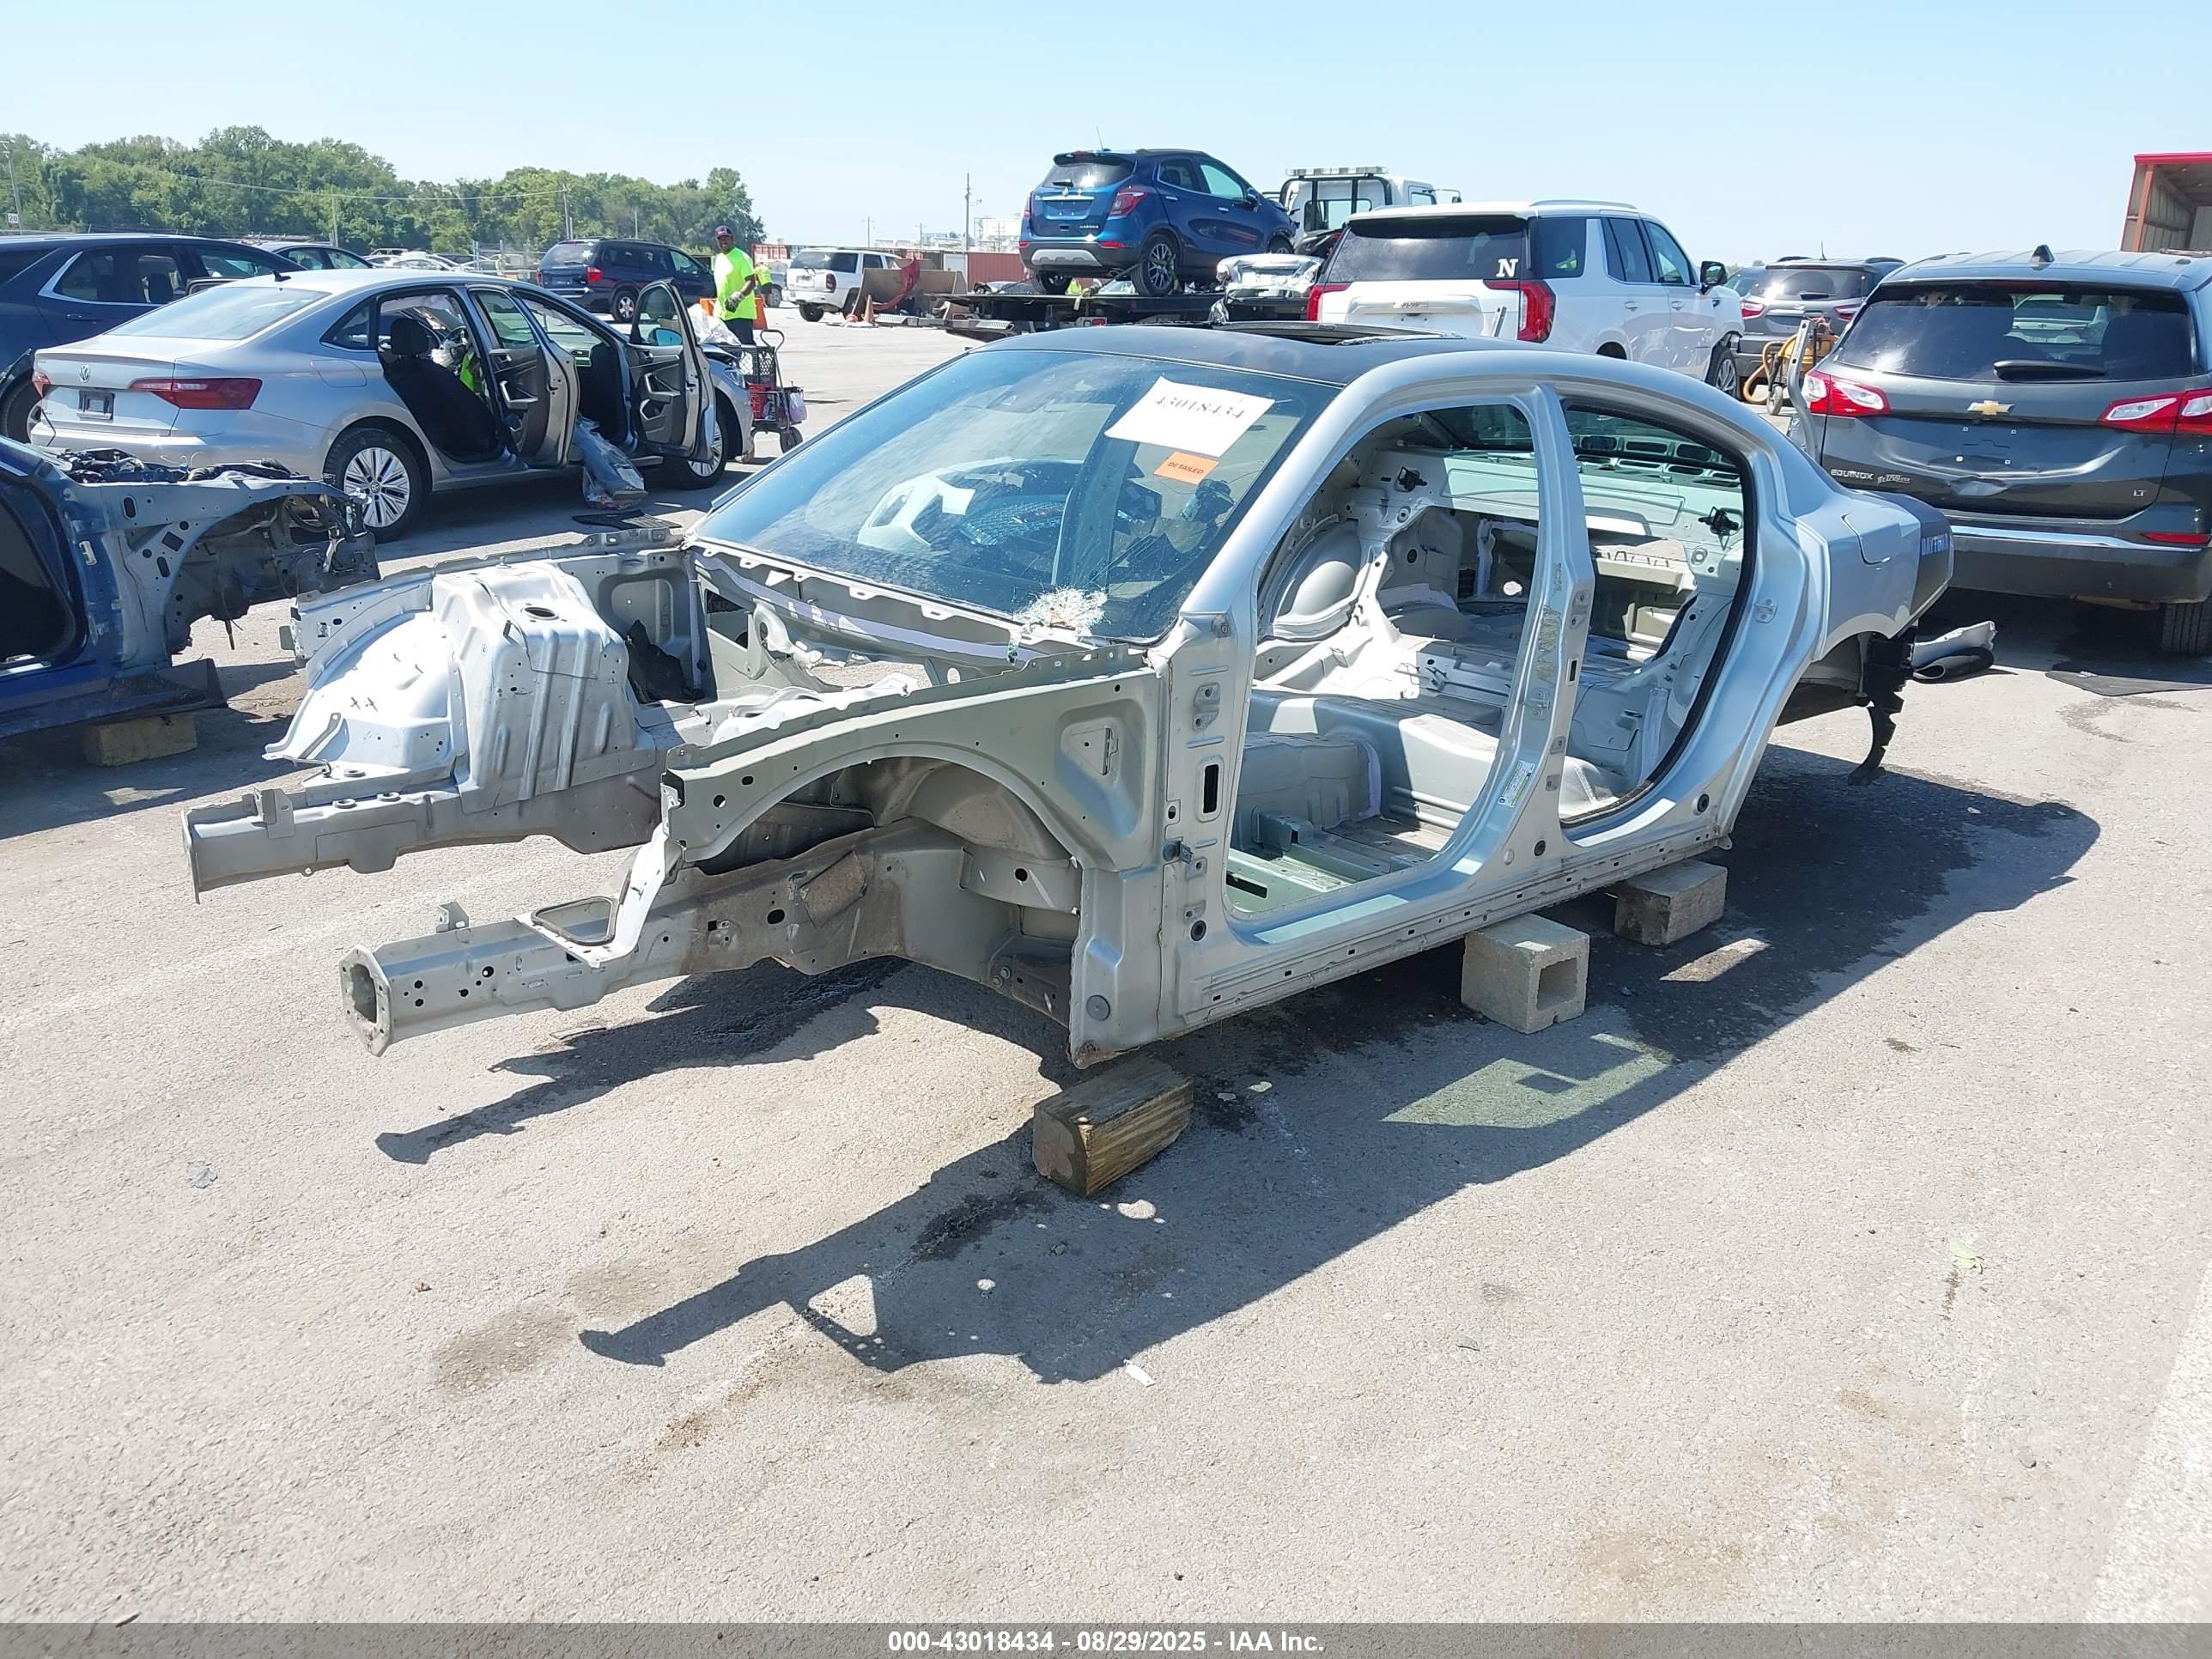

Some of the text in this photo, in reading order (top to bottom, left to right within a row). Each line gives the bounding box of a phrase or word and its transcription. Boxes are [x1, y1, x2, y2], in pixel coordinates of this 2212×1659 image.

[1496, 258, 1519, 277] N
[1168, 461, 1204, 474] DETAILED
[1831, 469, 1874, 480] EQUINOX
